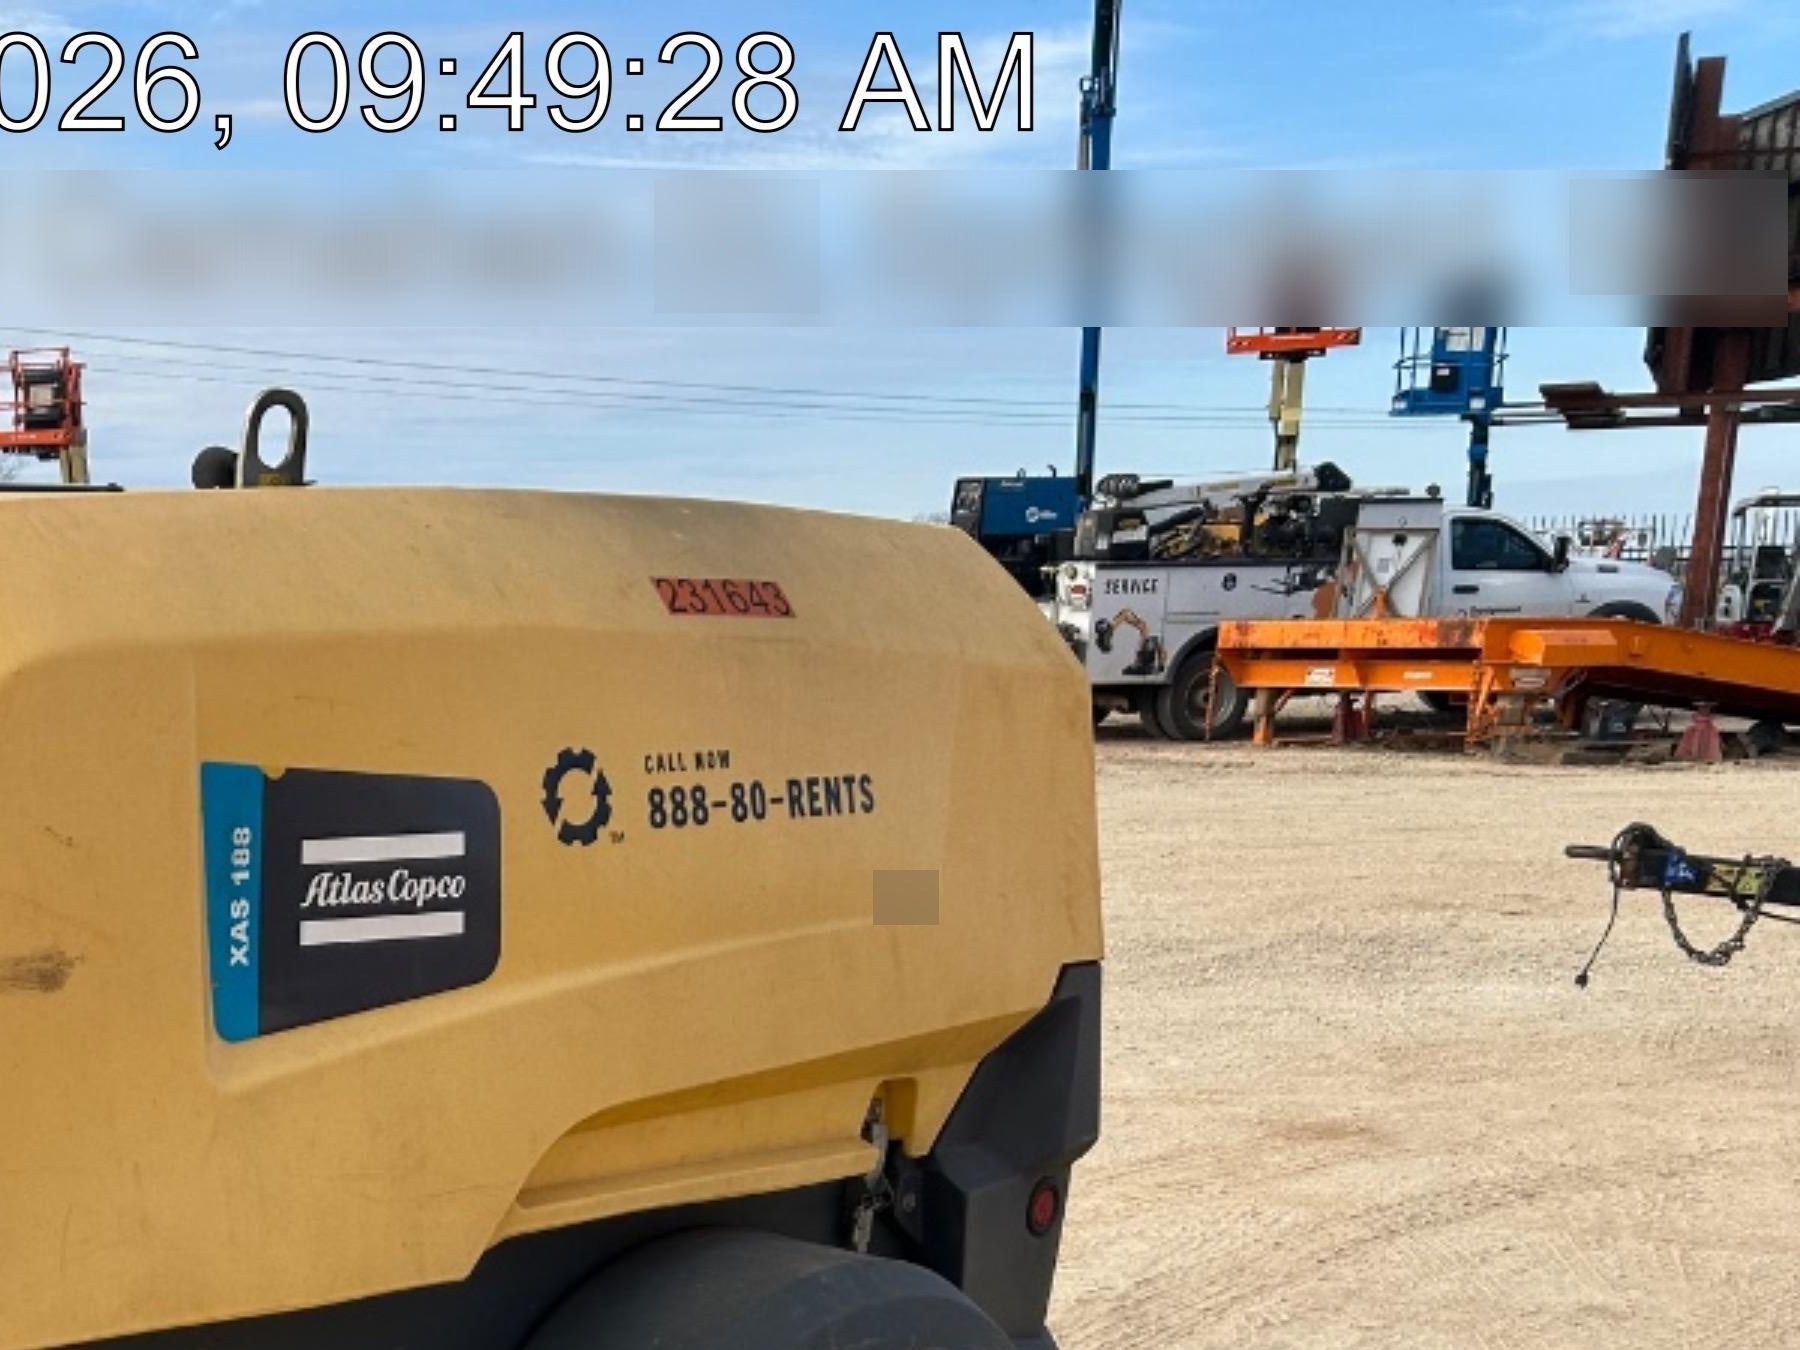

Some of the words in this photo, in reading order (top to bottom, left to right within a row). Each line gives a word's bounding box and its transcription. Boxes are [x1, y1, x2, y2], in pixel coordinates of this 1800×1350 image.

[654, 577, 791, 617] 231643
[644, 752, 688, 775] CALL
[694, 750, 731, 772] NOW
[648, 773, 876, 829] 888-80-RENTS
[230, 826, 252, 886] 188
[299, 871, 386, 908] Atlas
[387, 867, 467, 908] Copco
[229, 898, 251, 967] XAS
